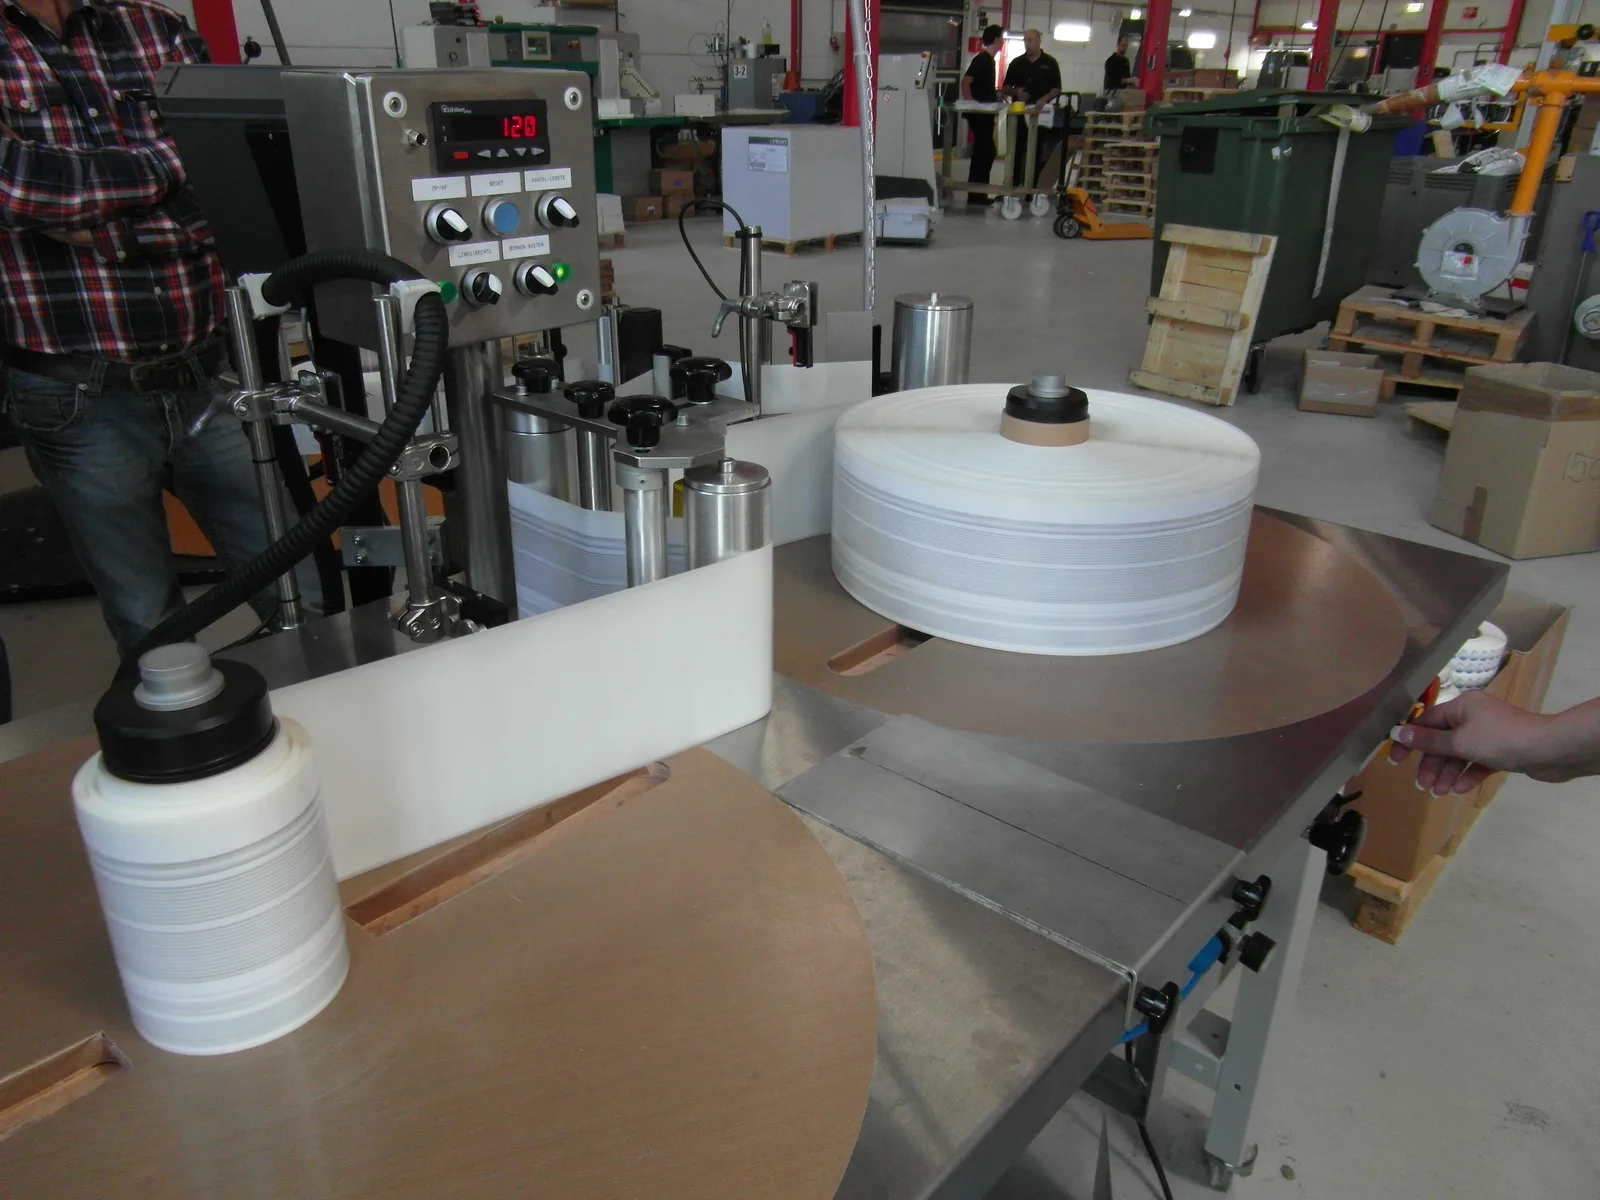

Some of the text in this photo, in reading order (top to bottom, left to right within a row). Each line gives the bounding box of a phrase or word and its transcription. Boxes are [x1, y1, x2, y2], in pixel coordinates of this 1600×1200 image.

[734, 66, 746, 76] 3-2
[504, 115, 536, 138] 120
[457, 248, 493, 258] LINKS/RECHTS
